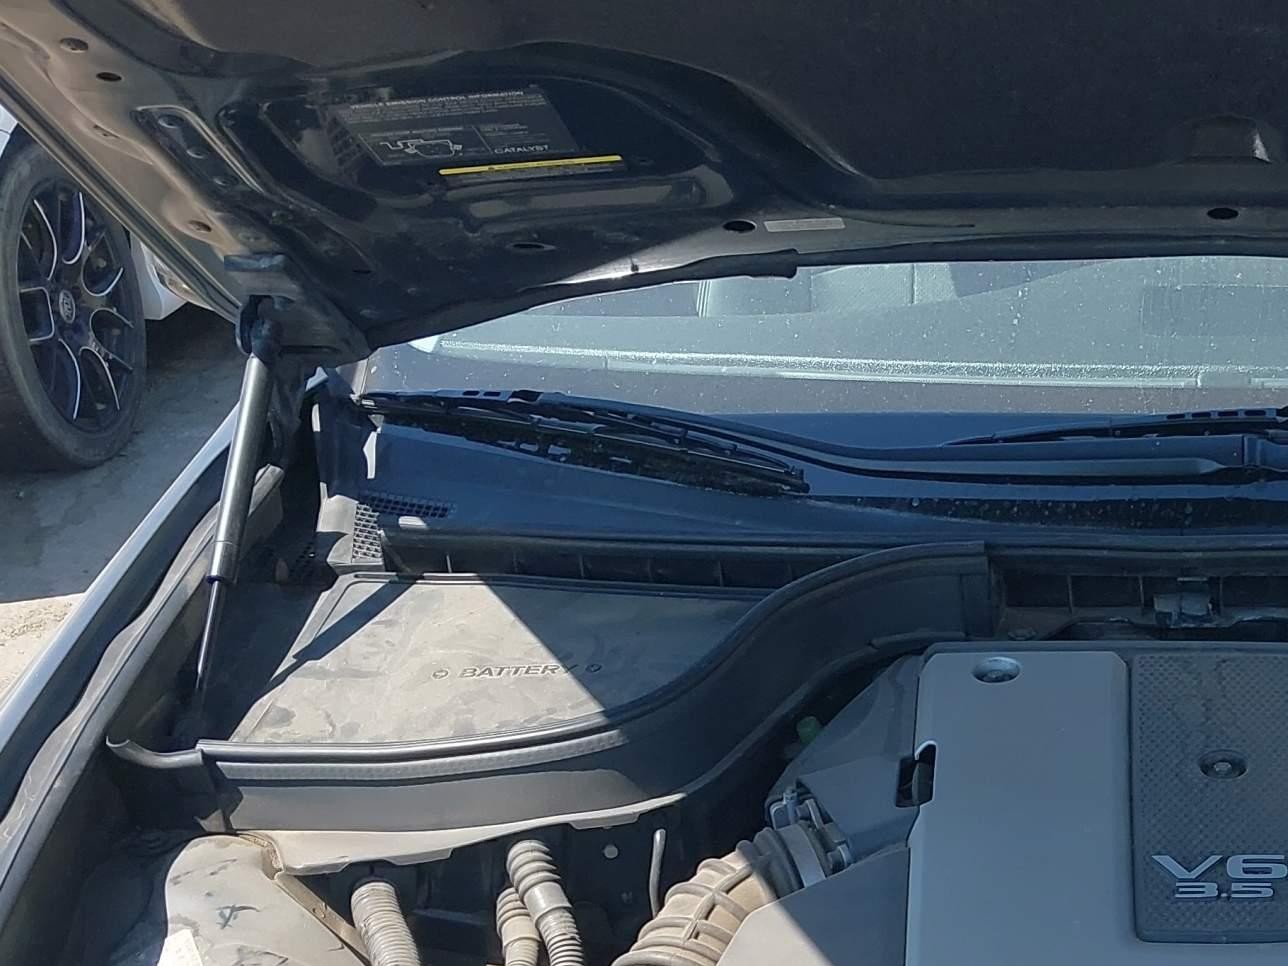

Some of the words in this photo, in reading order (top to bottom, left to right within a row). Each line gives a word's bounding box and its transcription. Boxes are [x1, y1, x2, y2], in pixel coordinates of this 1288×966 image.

[494, 144, 549, 154] CATALYST
[459, 663, 578, 679] BATTERY
[1151, 854, 1288, 880] V6
[1175, 882, 1274, 898] 3.5
